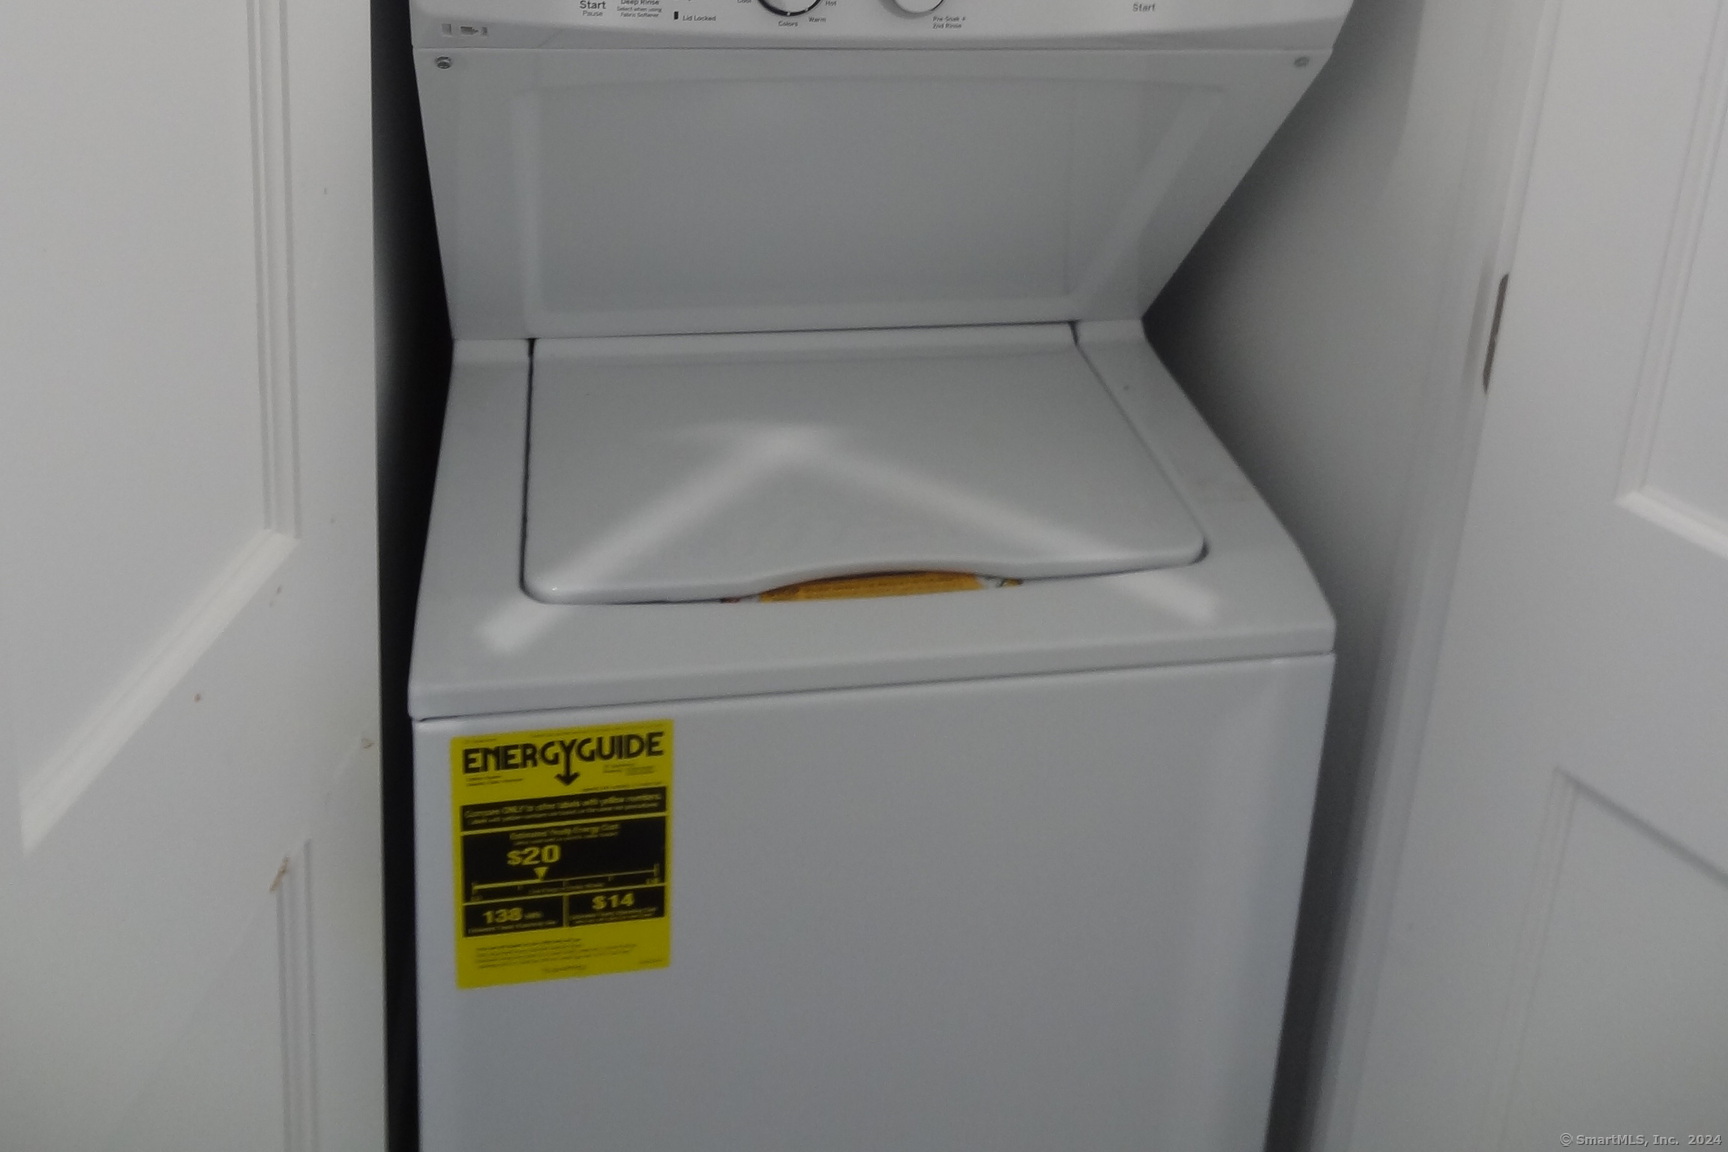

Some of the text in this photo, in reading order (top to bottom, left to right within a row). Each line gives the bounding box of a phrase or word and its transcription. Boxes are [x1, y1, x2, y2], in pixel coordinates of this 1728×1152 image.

[580, 0, 606, 10] Start
[1132, 3, 1156, 13] Start
[462, 731, 664, 774] ENERGYGUIDE
[507, 844, 561, 866] $20
[592, 892, 635, 910] $14
